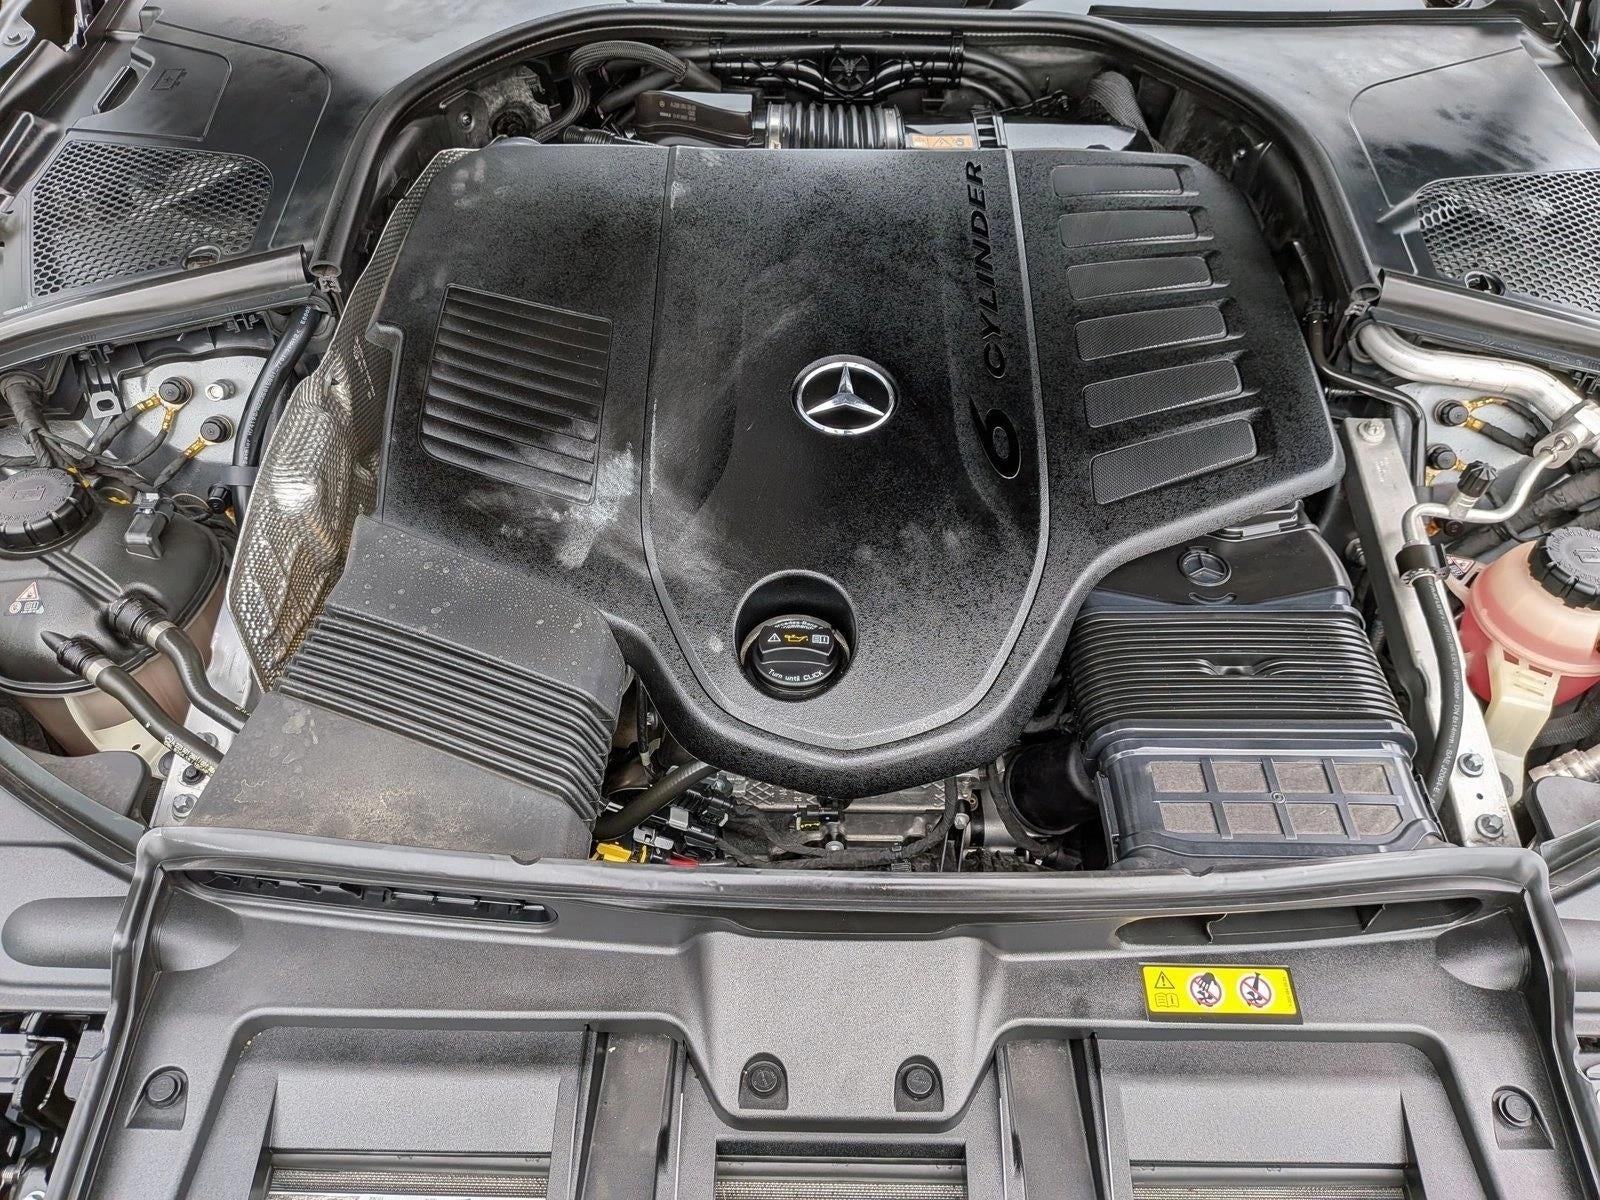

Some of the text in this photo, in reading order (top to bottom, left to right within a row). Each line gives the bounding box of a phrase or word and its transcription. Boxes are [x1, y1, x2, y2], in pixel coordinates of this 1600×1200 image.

[966, 160, 1022, 480] 6 CYLINDER
[768, 668, 783, 679] Turn
[803, 669, 824, 681] CLICK
